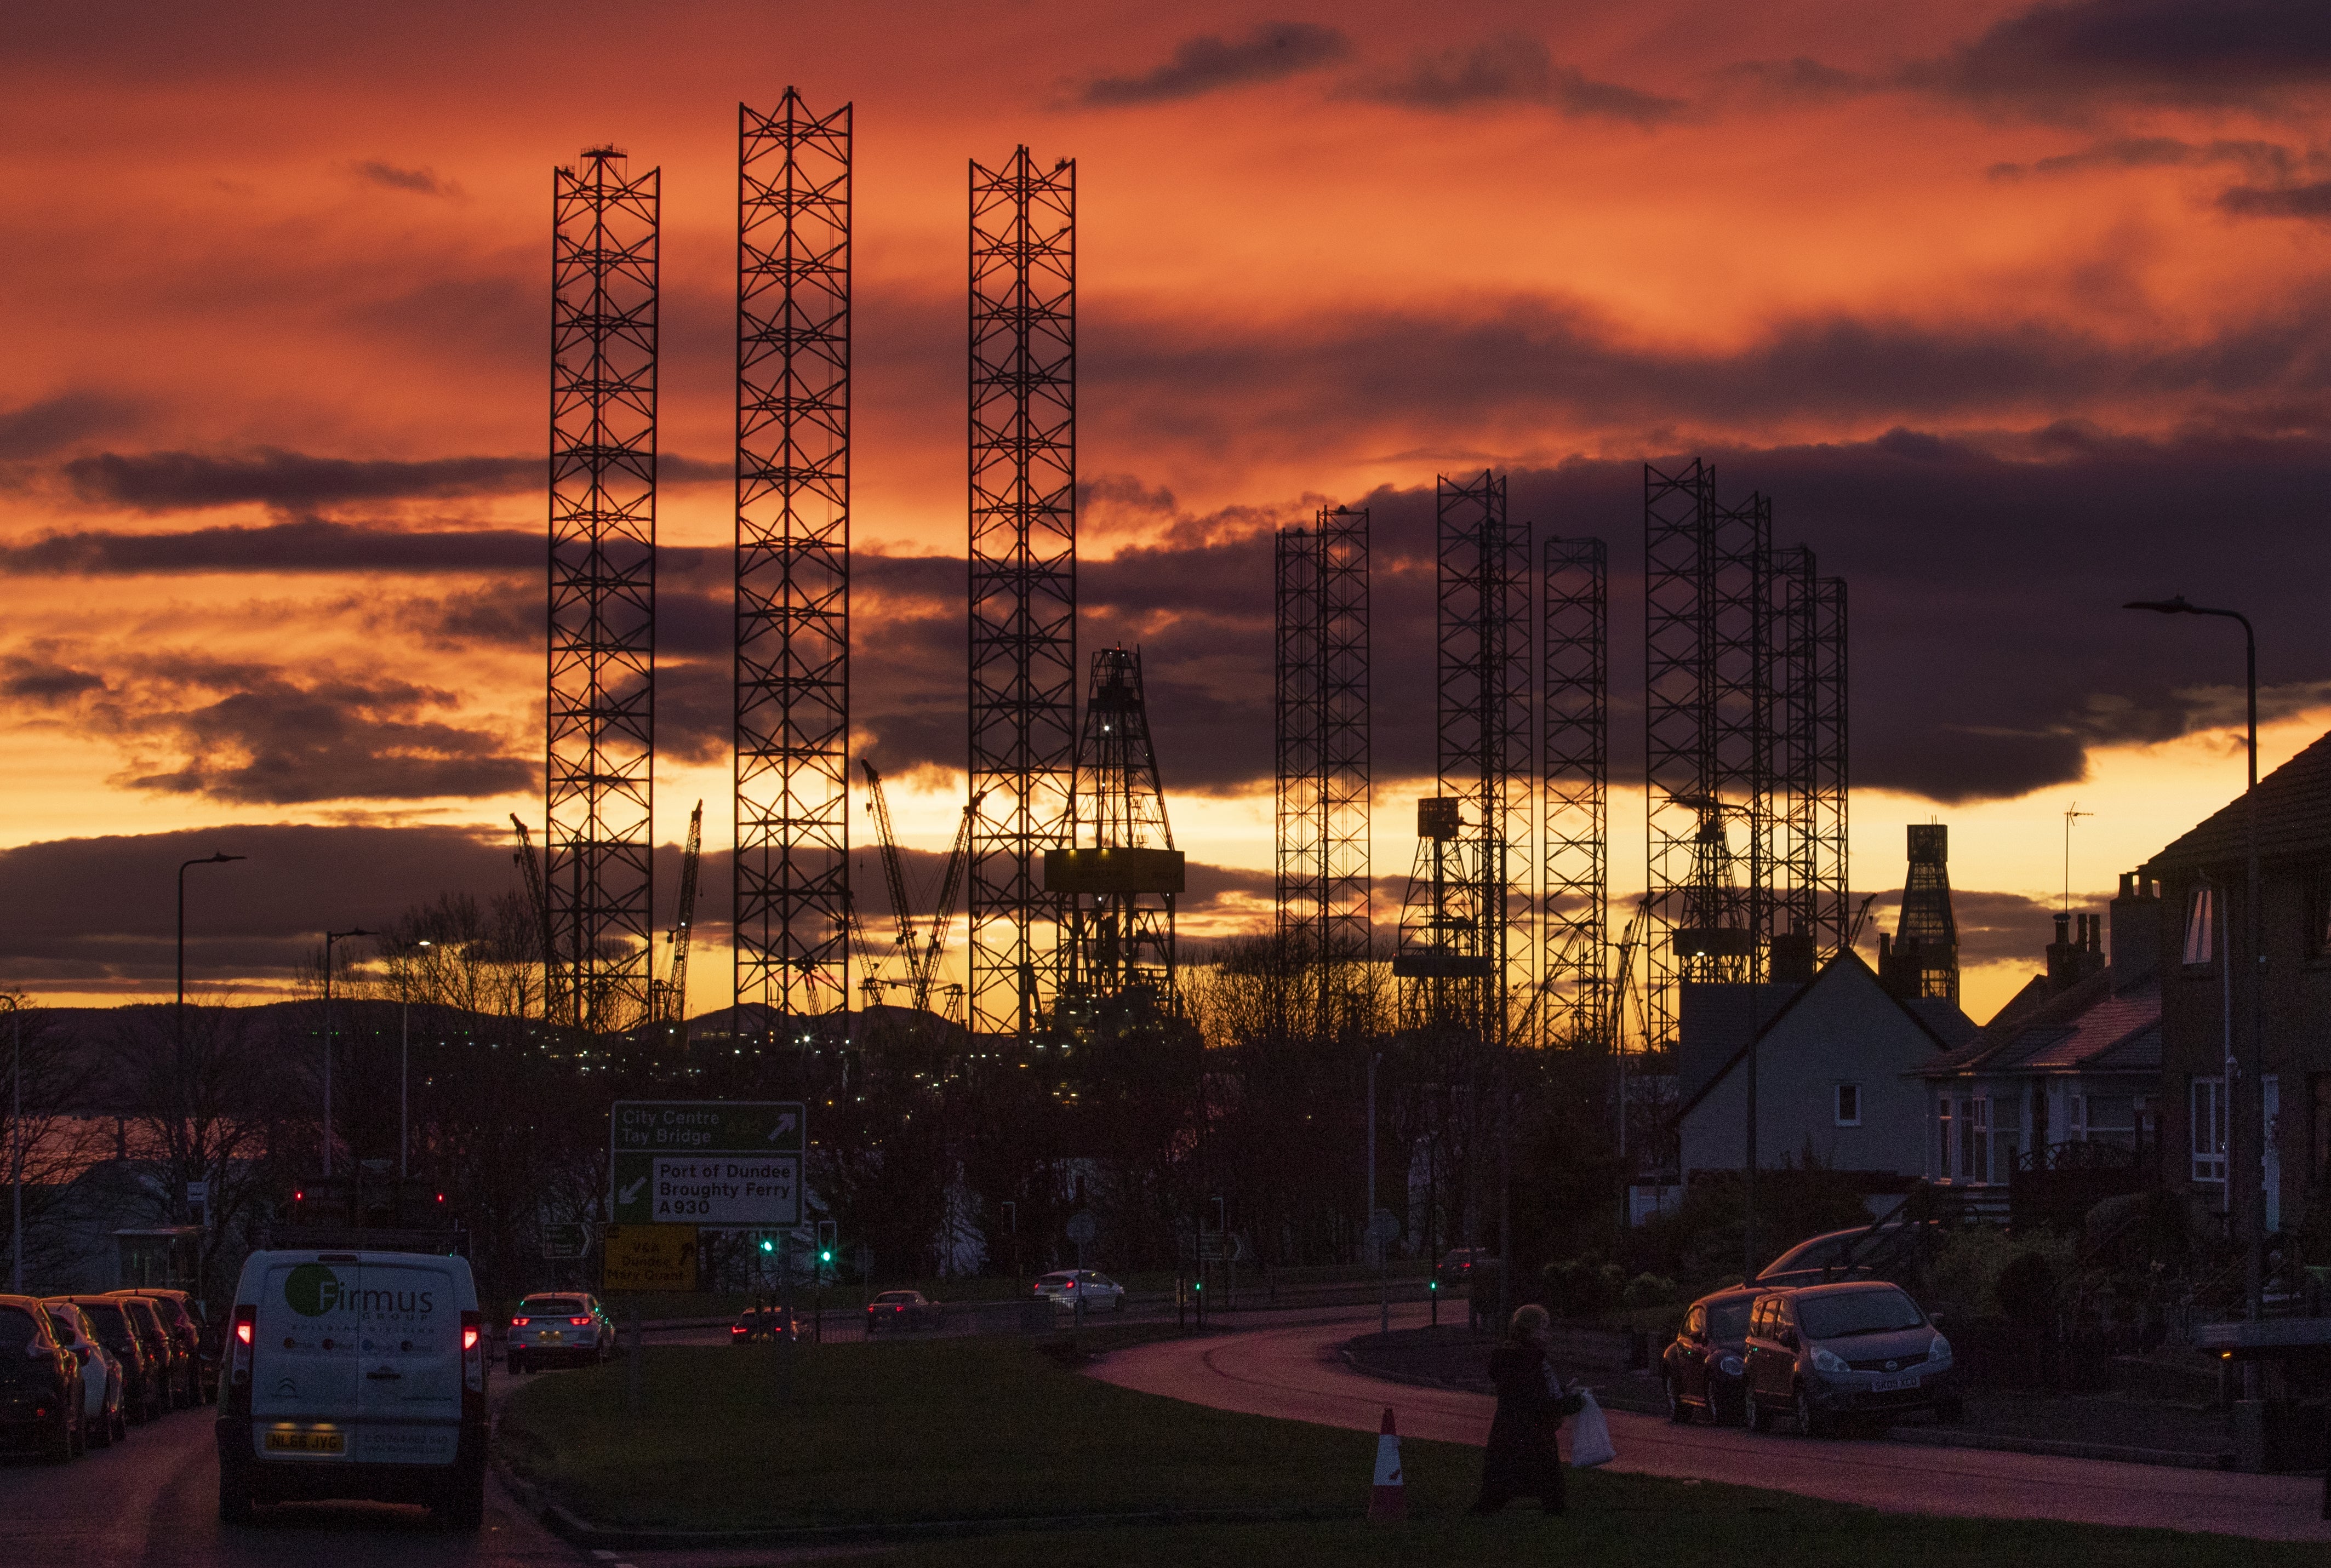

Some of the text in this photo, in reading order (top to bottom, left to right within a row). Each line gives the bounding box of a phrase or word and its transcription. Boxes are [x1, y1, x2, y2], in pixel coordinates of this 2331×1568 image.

[622, 1109, 719, 1126] City Centre
[621, 1128, 711, 1145] Tay Bridge
[660, 1164, 790, 1178] Port of Dundee
[660, 1182, 790, 1198] Broughty Ferry
[633, 1242, 659, 1252] V&A
[622, 1256, 671, 1267] Dundee
[607, 1269, 684, 1281] Mary Quant
[319, 1281, 433, 1313] Firmus
[361, 1312, 428, 1321] GROUP
[271, 1435, 337, 1449] NL66 JYG
